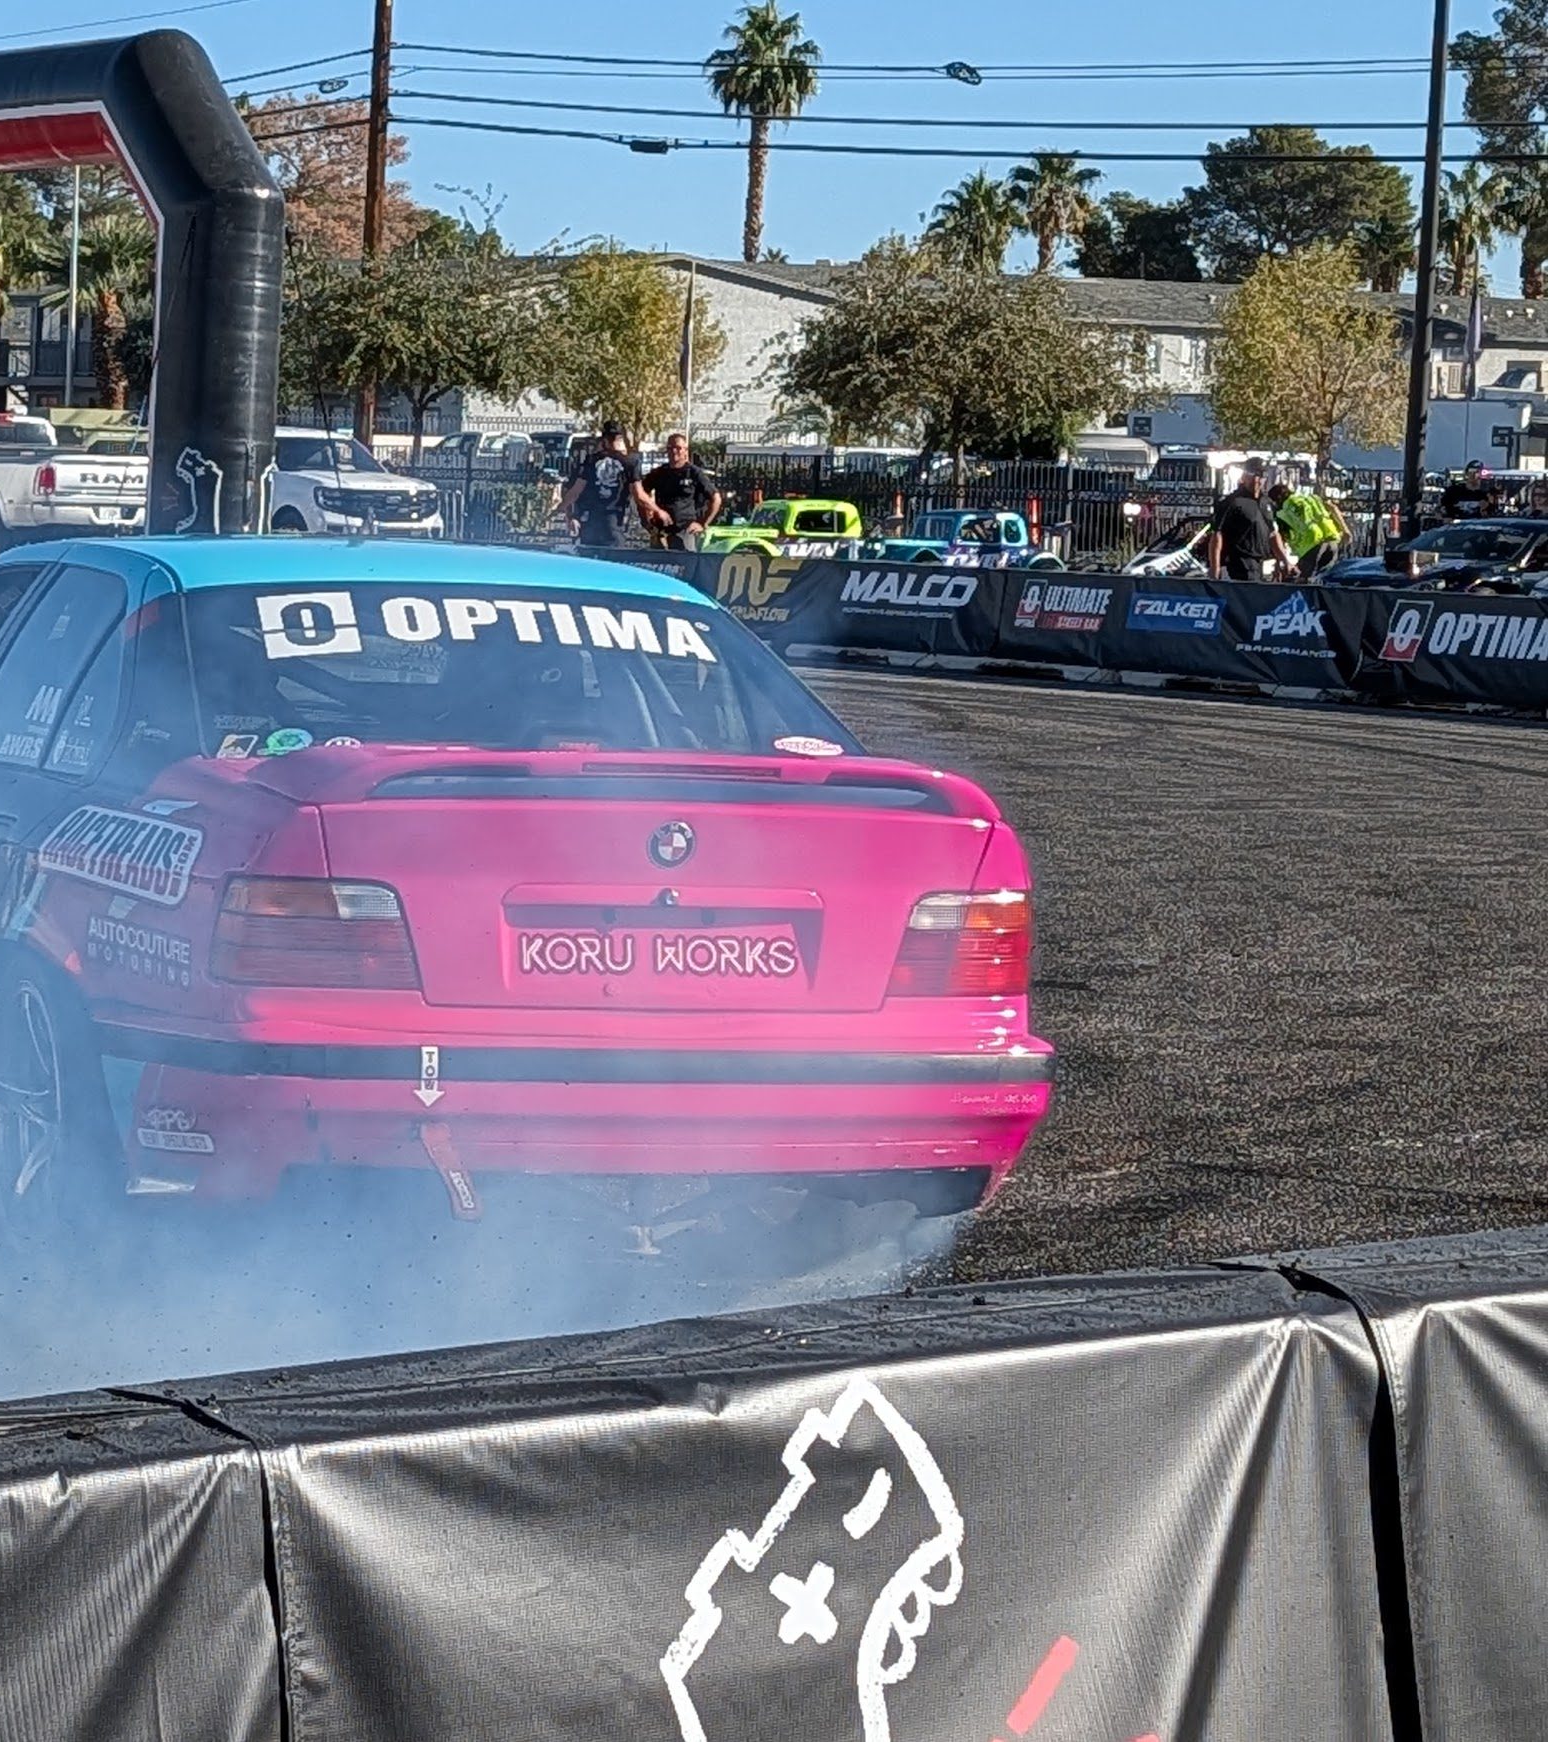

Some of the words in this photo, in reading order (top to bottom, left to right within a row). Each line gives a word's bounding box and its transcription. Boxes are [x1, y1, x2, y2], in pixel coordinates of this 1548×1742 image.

[80, 473, 144, 484] RAM
[840, 571, 977, 607] MALCO
[1044, 585, 1114, 615] ULTIMATE
[1135, 600, 1219, 619] FALKEN
[1253, 610, 1328, 641] PEAK
[1429, 611, 1548, 662] OPTIMA
[88, 916, 191, 963] AUTOCOUTURE
[520, 935, 634, 973] KORU
[654, 935, 798, 975] WORKS
[424, 1050, 437, 1090] TOW
